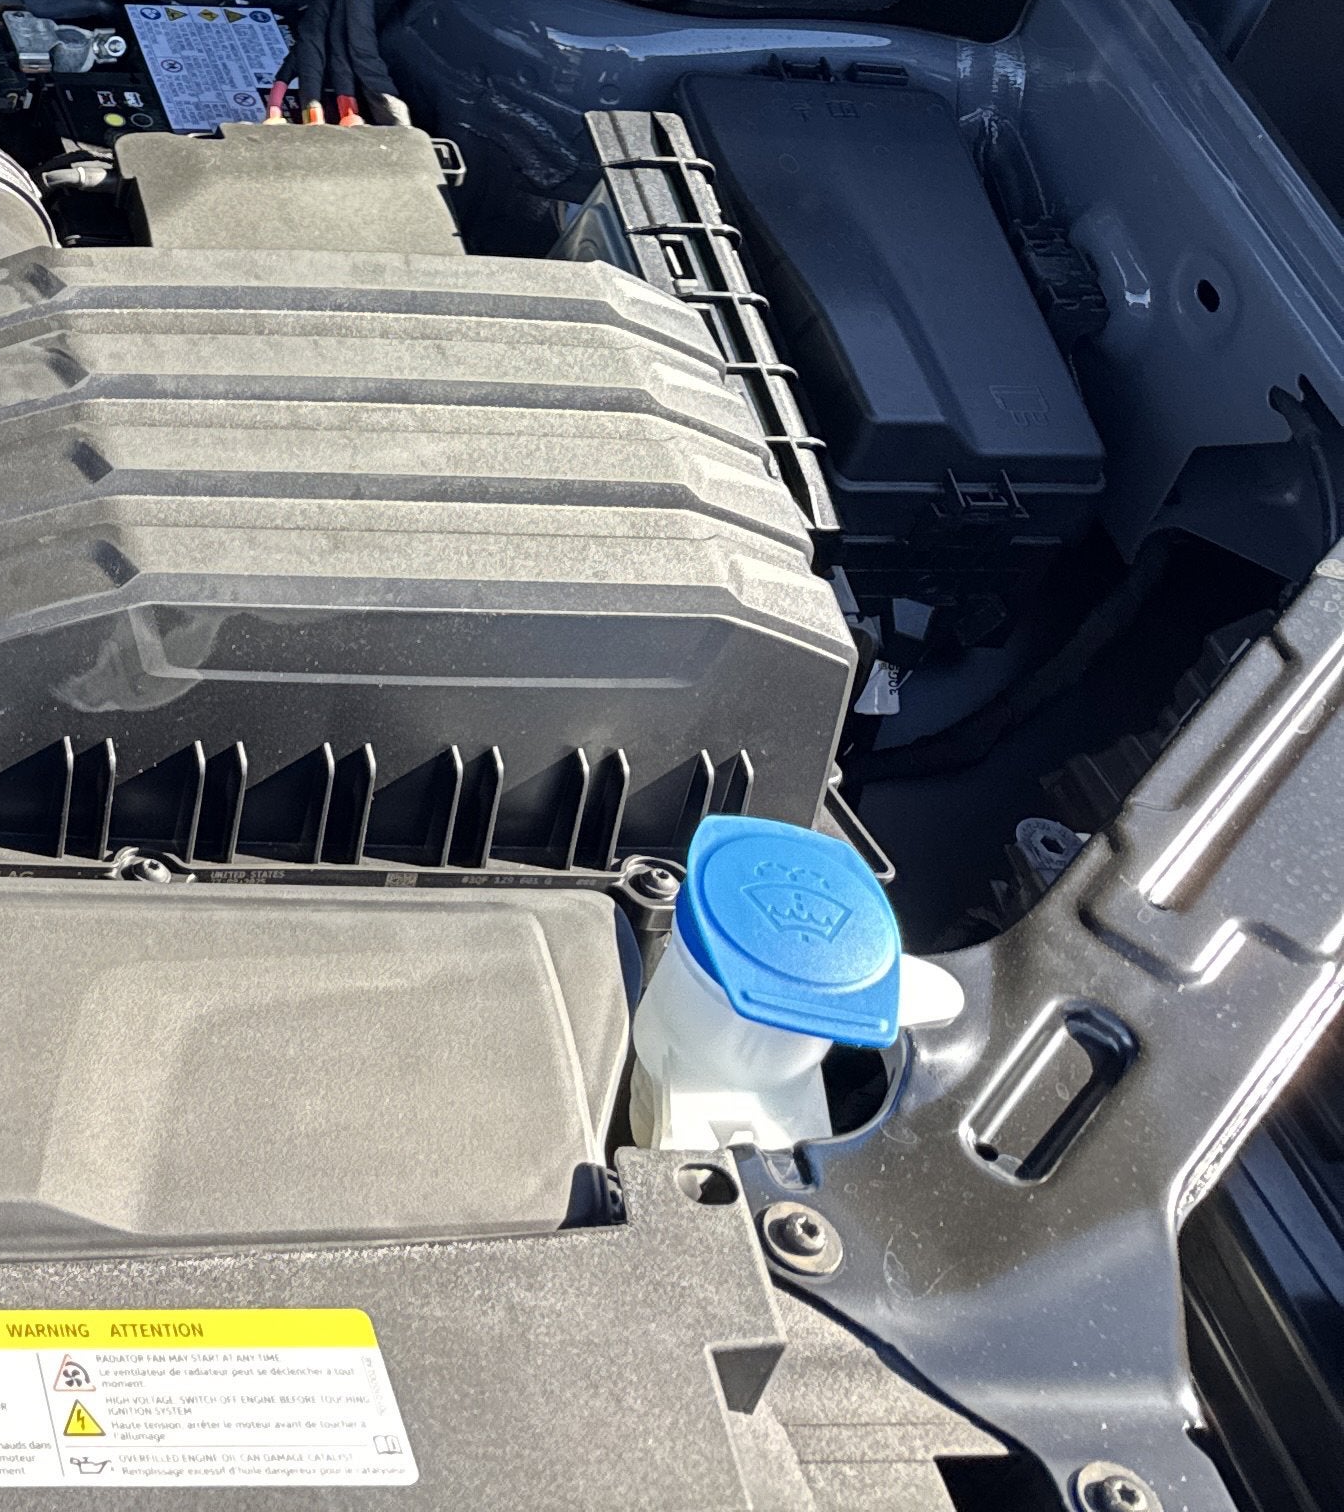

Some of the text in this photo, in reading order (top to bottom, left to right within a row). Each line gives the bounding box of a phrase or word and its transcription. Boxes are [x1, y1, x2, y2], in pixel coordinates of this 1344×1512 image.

[5, 1323, 204, 1338] WARNING ATTENTION
[95, 1354, 255, 1363] RADIATOR FAN MAY START AT ANY
[169, 1368, 181, 1376] de
[184, 1368, 228, 1376] radiateur
[231, 1368, 254, 1378] peut
[334, 1367, 355, 1376] tout
[105, 1396, 130, 1404] HIGH
[180, 1396, 217, 1404] SWITCH
[219, 1396, 237, 1404] OFF
[240, 1396, 276, 1404] ENGINE
[279, 1395, 317, 1404] BEFORE
[108, 1407, 192, 1416] IGNITION SYSTEM
[111, 1421, 142, 1429] Haute
[223, 1421, 233, 1429] le
[235, 1421, 270, 1429] moteur
[274, 1421, 302, 1429] avant
[304, 1420, 317, 1429] de
[29, 1441, 52, 1450] dans
[0, 1455, 36, 1463] moteur
[118, 1454, 179, 1463] OVERFILLED
[182, 1454, 217, 1463] ENGINE
[240, 1454, 260, 1462] CAN
[263, 1454, 304, 1462] DAMAGE
